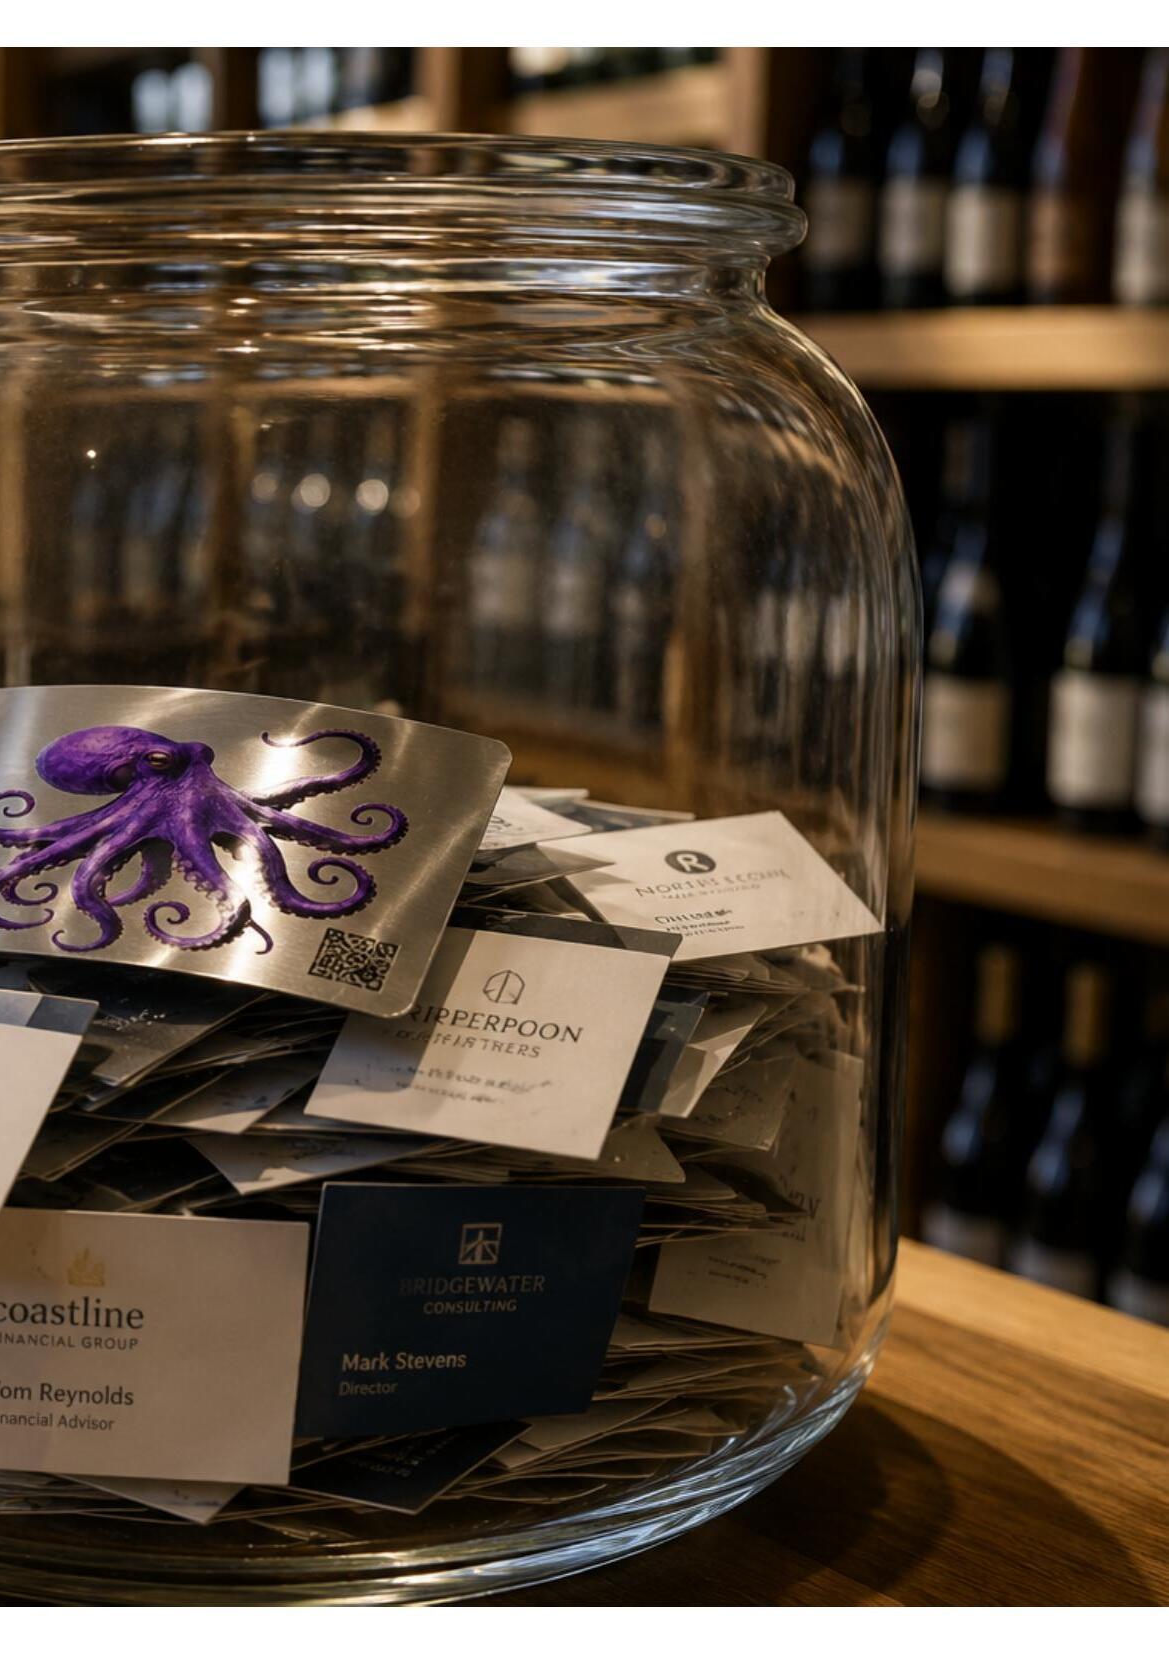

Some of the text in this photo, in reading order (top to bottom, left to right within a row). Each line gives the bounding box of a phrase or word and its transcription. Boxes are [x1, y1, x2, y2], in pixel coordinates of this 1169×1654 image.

[399, 1275, 546, 1297] BRIDGEWATER
[423, 1299, 517, 1315] CONSULTING
[80, 1336, 139, 1350] GROUP
[341, 1352, 467, 1371] Mark Stevens
[39, 1382, 135, 1408] Reynolds
[338, 1381, 398, 1396] Director
[57, 1414, 116, 1431] Advisor
